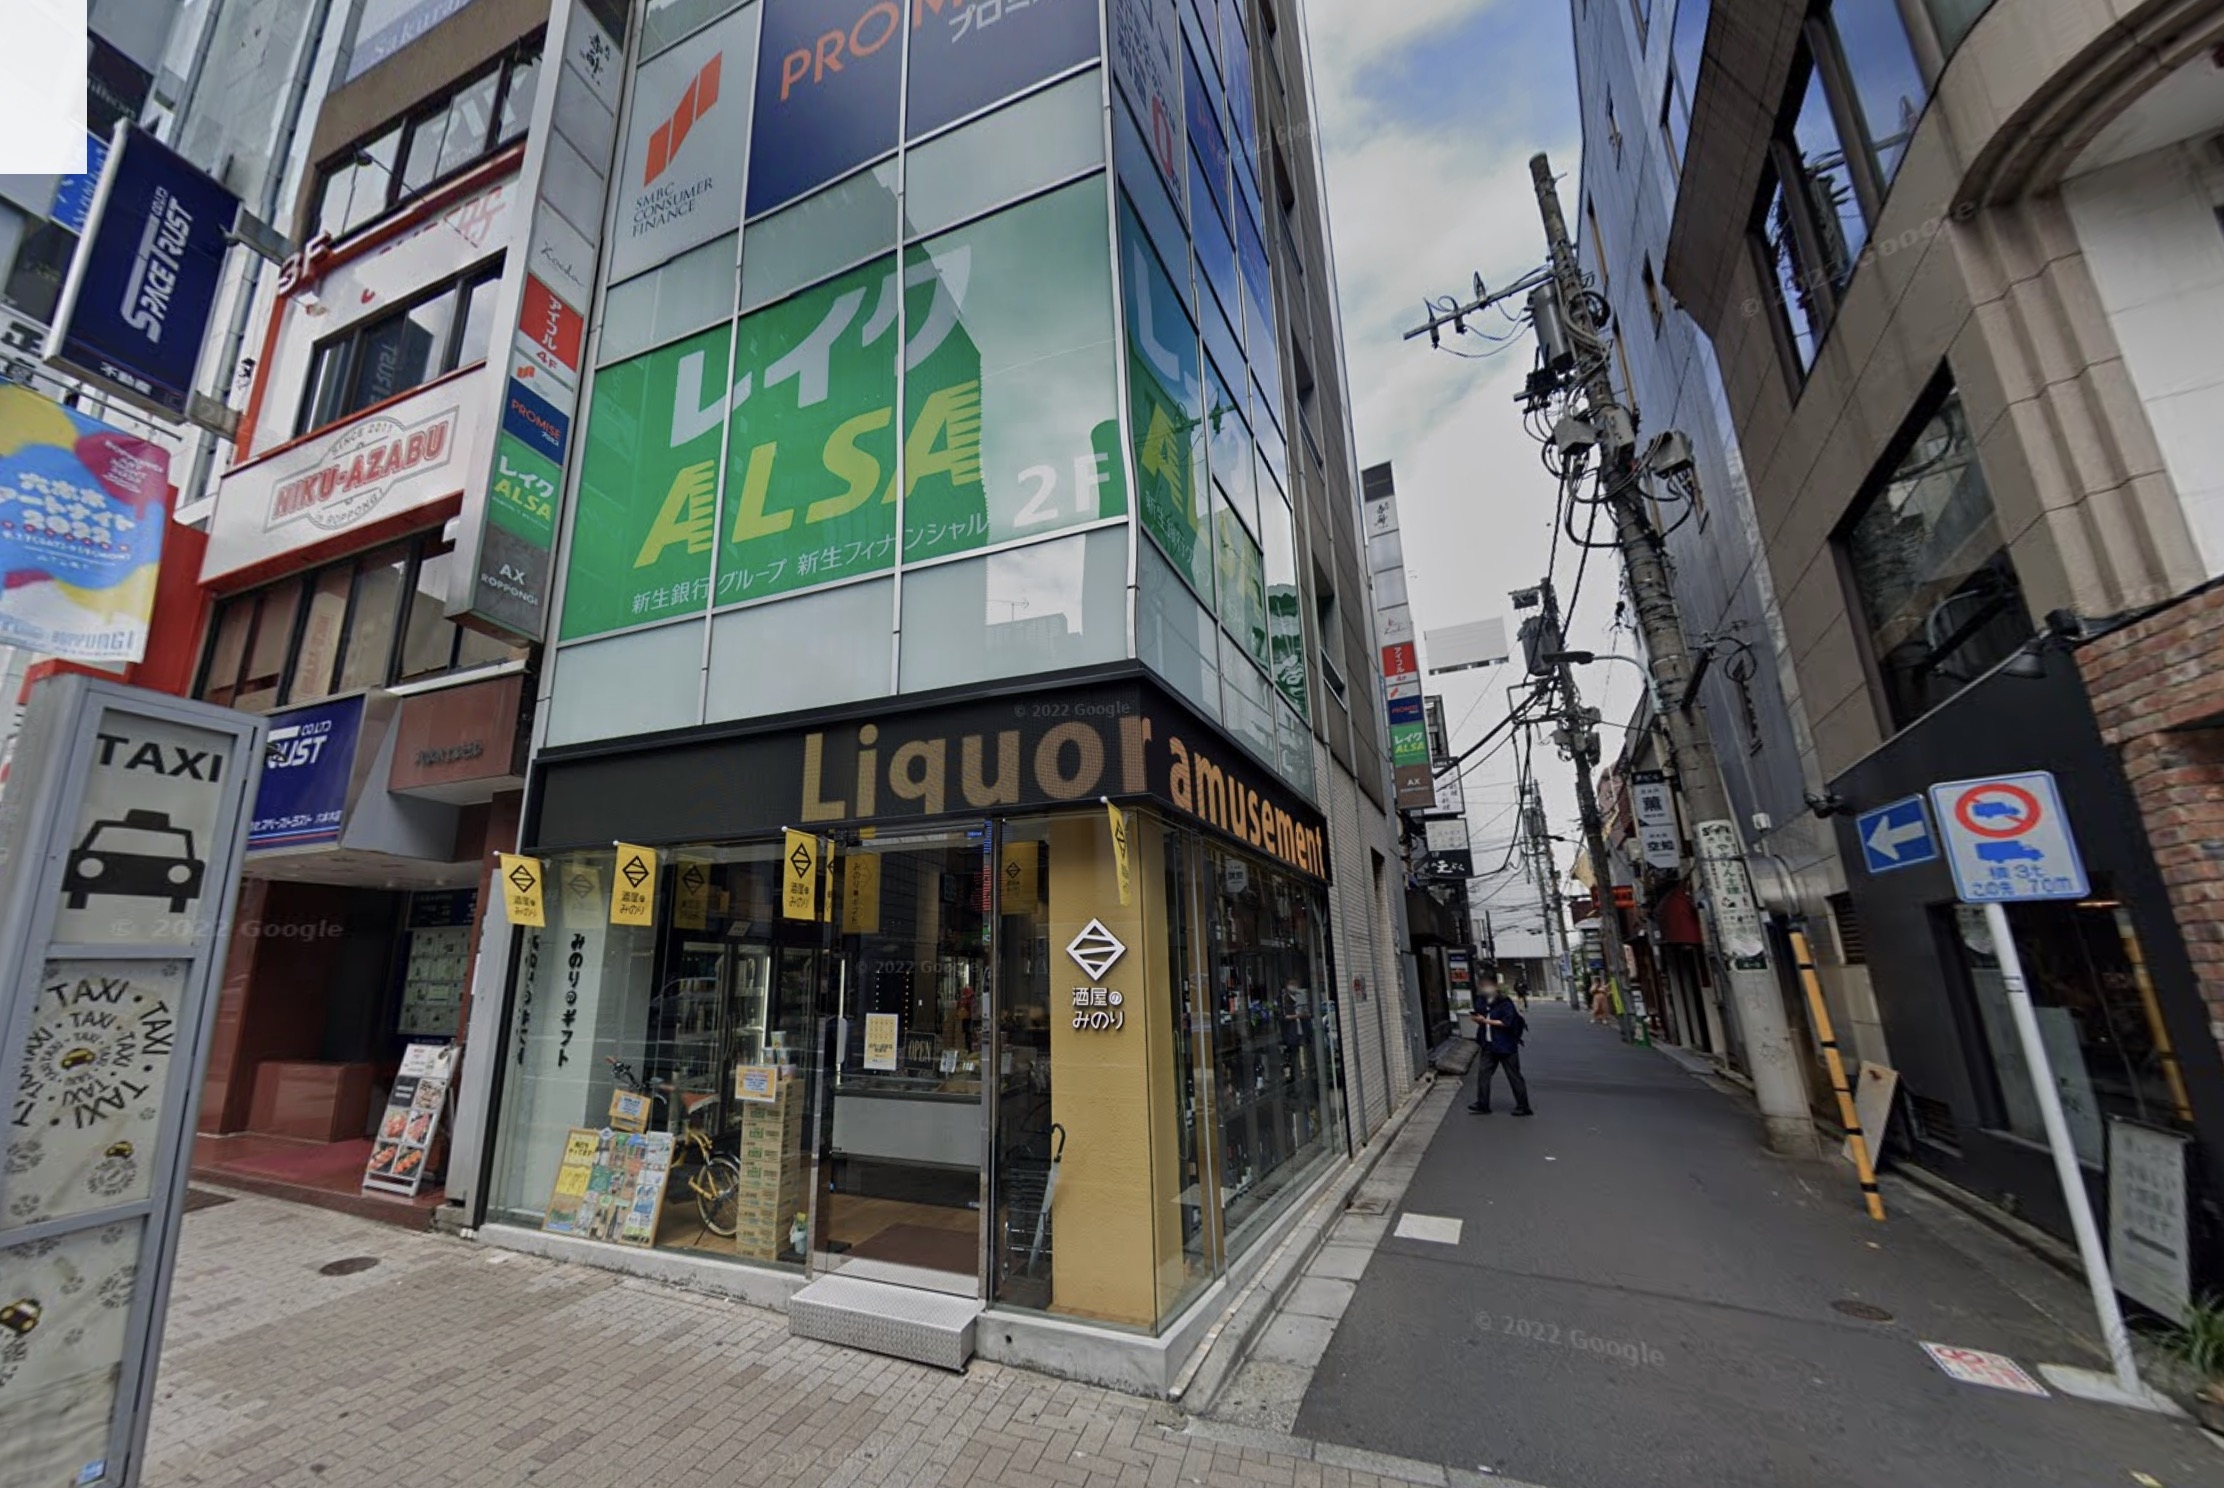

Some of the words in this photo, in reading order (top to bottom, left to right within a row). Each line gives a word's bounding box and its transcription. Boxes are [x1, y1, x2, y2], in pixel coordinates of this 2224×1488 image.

[633, 176, 714, 224] CONSUMER
[636, 181, 676, 209] SMBC
[632, 199, 696, 238] FINANCE
[278, 229, 333, 296] 3F
[546, 295, 558, 352] アイフル
[536, 350, 558, 370] 4F
[670, 244, 972, 449] レイク
[510, 398, 562, 440] PROMISE
[499, 455, 554, 498] レイク
[633, 378, 983, 569] ALSA
[1012, 452, 1112, 530] 2F
[493, 478, 552, 521] ALSA
[481, 572, 539, 606] ROPPONGI
[499, 563, 525, 585] AX
[1394, 731, 1423, 744] レイク
[1395, 742, 1425, 754] ALSA
[96, 732, 224, 785] TAXI
[801, 722, 1152, 823] Liquor
[1406, 778, 1421, 786] AX
[1168, 732, 1330, 880] amusement
[2027, 876, 2075, 894] 70m
[45, 977, 130, 1008] TAXI
[1071, 986, 1124, 1007] 酒屋の
[69, 1010, 118, 1030] TAXI
[137, 999, 176, 1056] TAXI
[1071, 1010, 1125, 1031] みのり
[112, 1031, 136, 1069] TAXI
[907, 1039, 932, 1062] OPEN
[74, 1079, 150, 1130] TAXI
